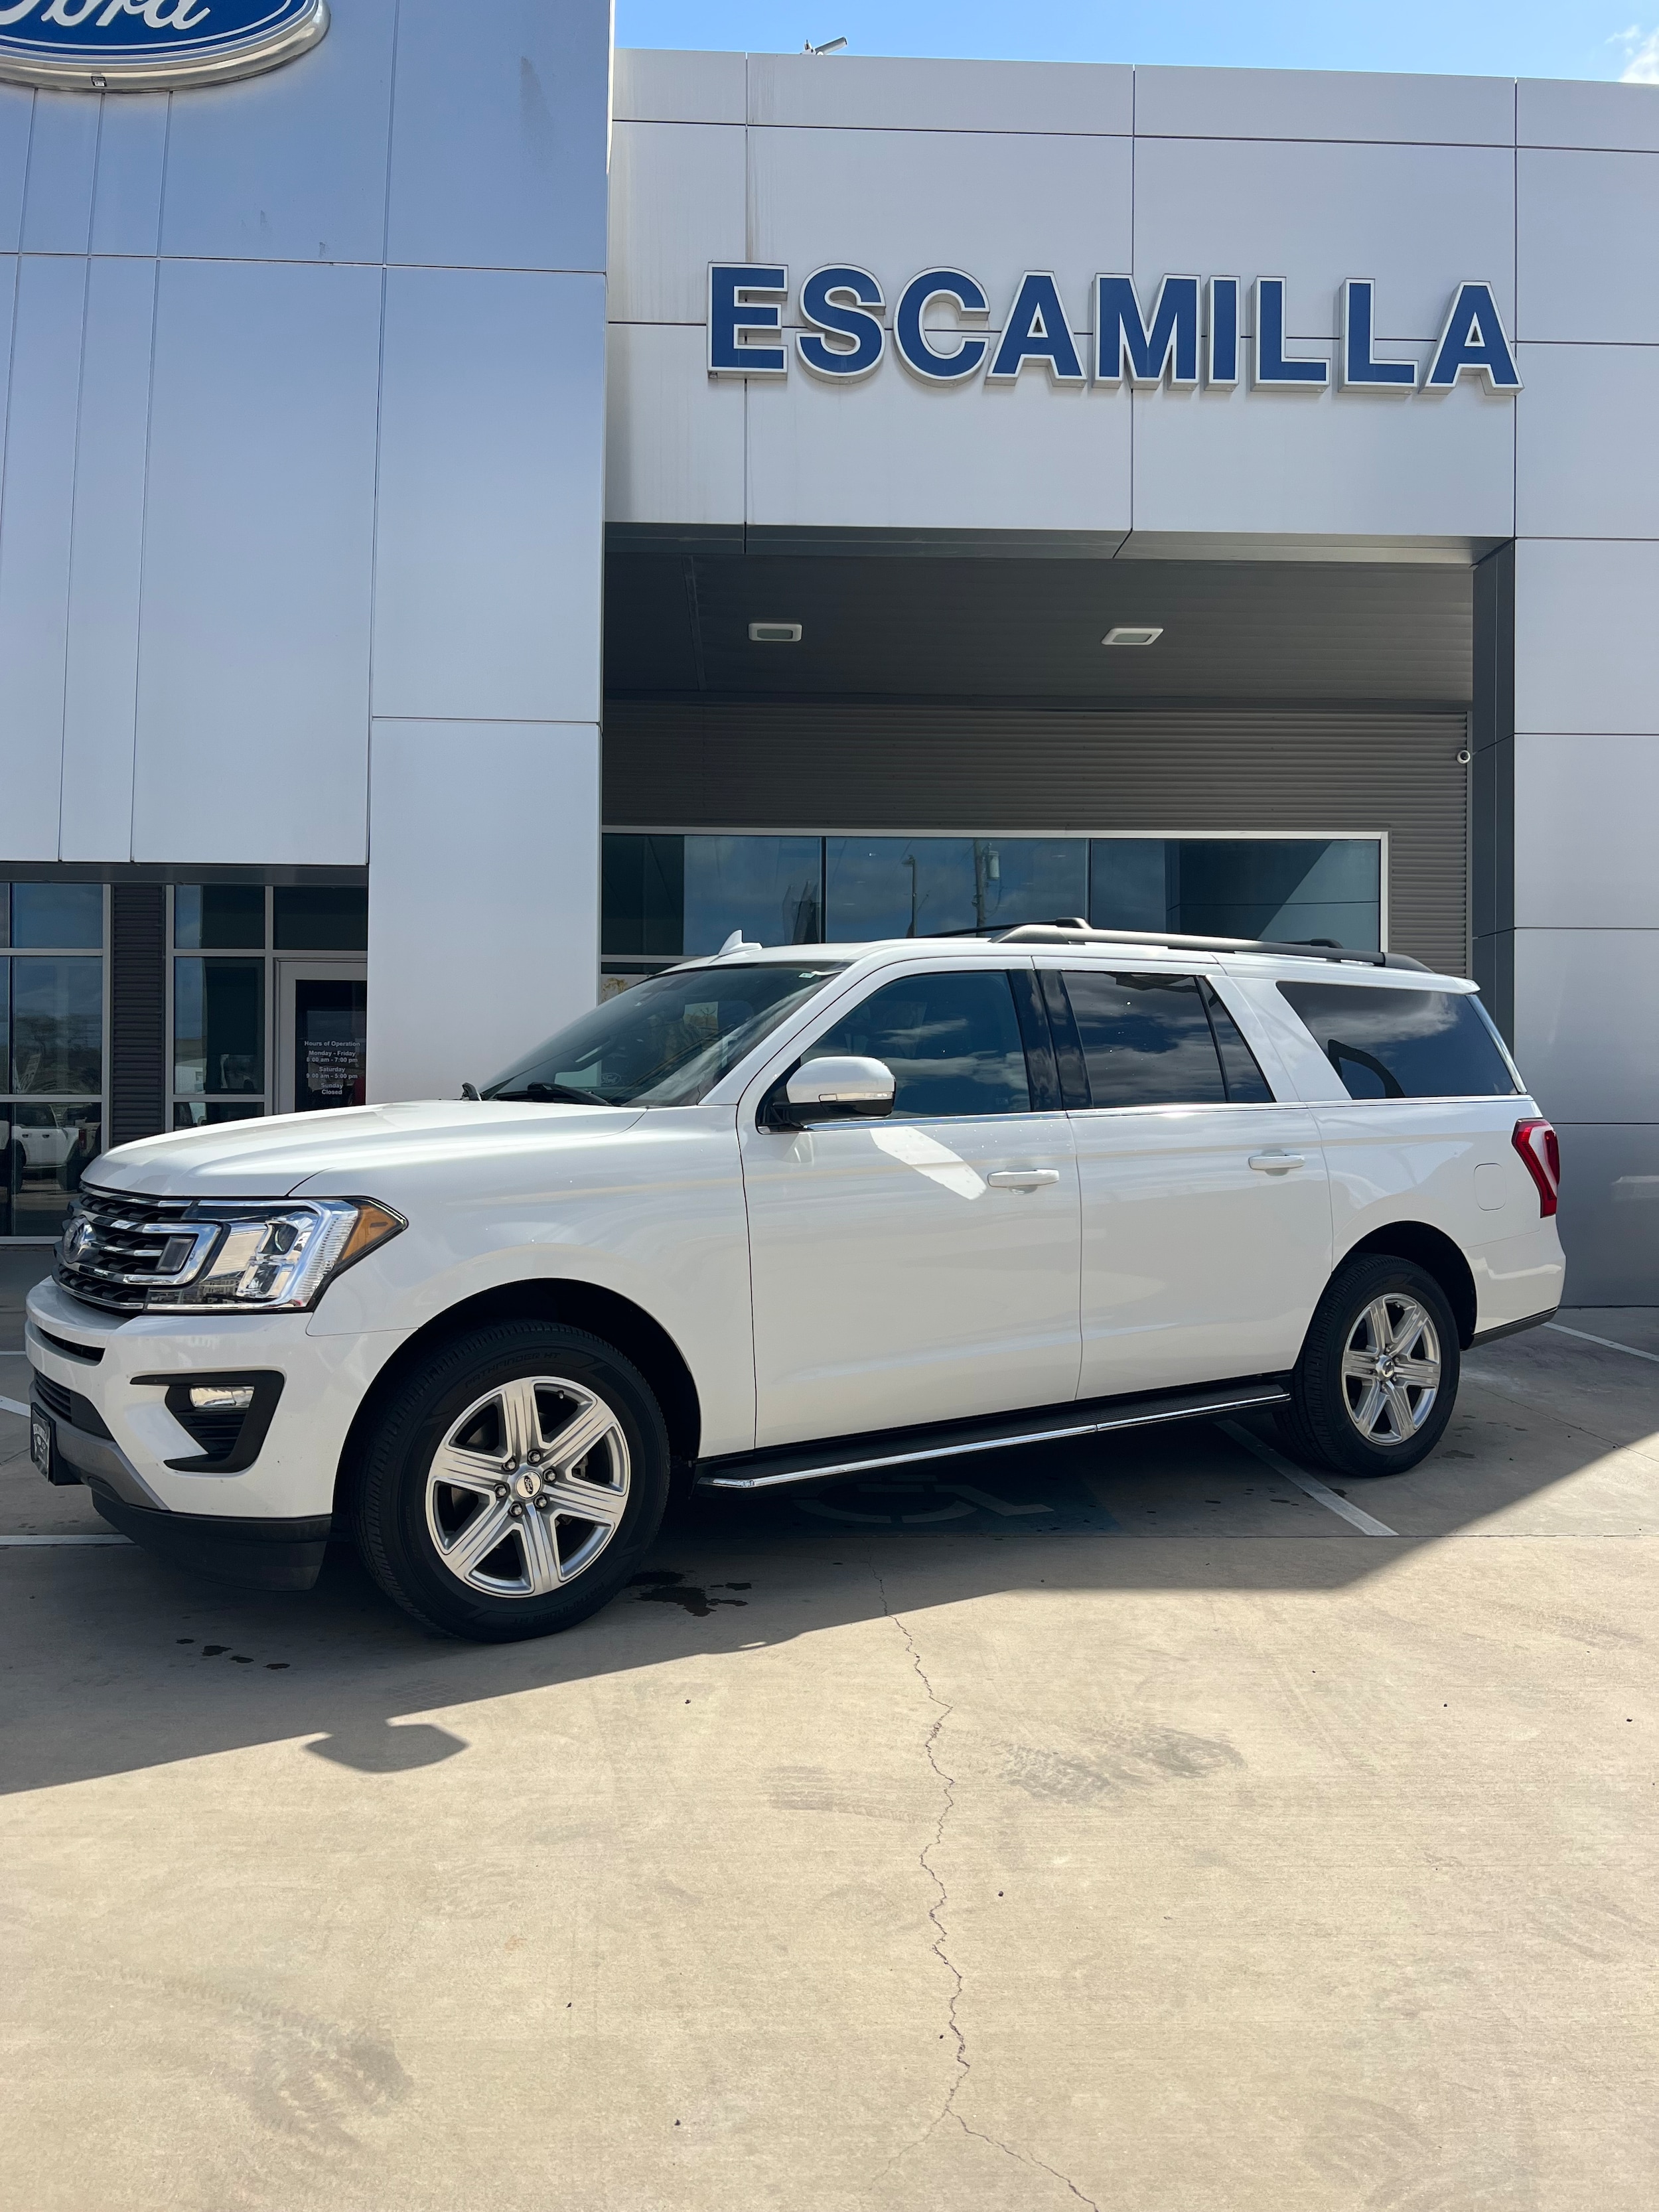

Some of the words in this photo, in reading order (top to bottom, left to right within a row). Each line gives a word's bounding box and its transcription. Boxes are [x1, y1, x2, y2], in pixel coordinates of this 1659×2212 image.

[0, 0, 211, 30] ord
[707, 261, 1522, 391] ESCAMILLA
[465, 1353, 540, 1388] PATHFINDER
